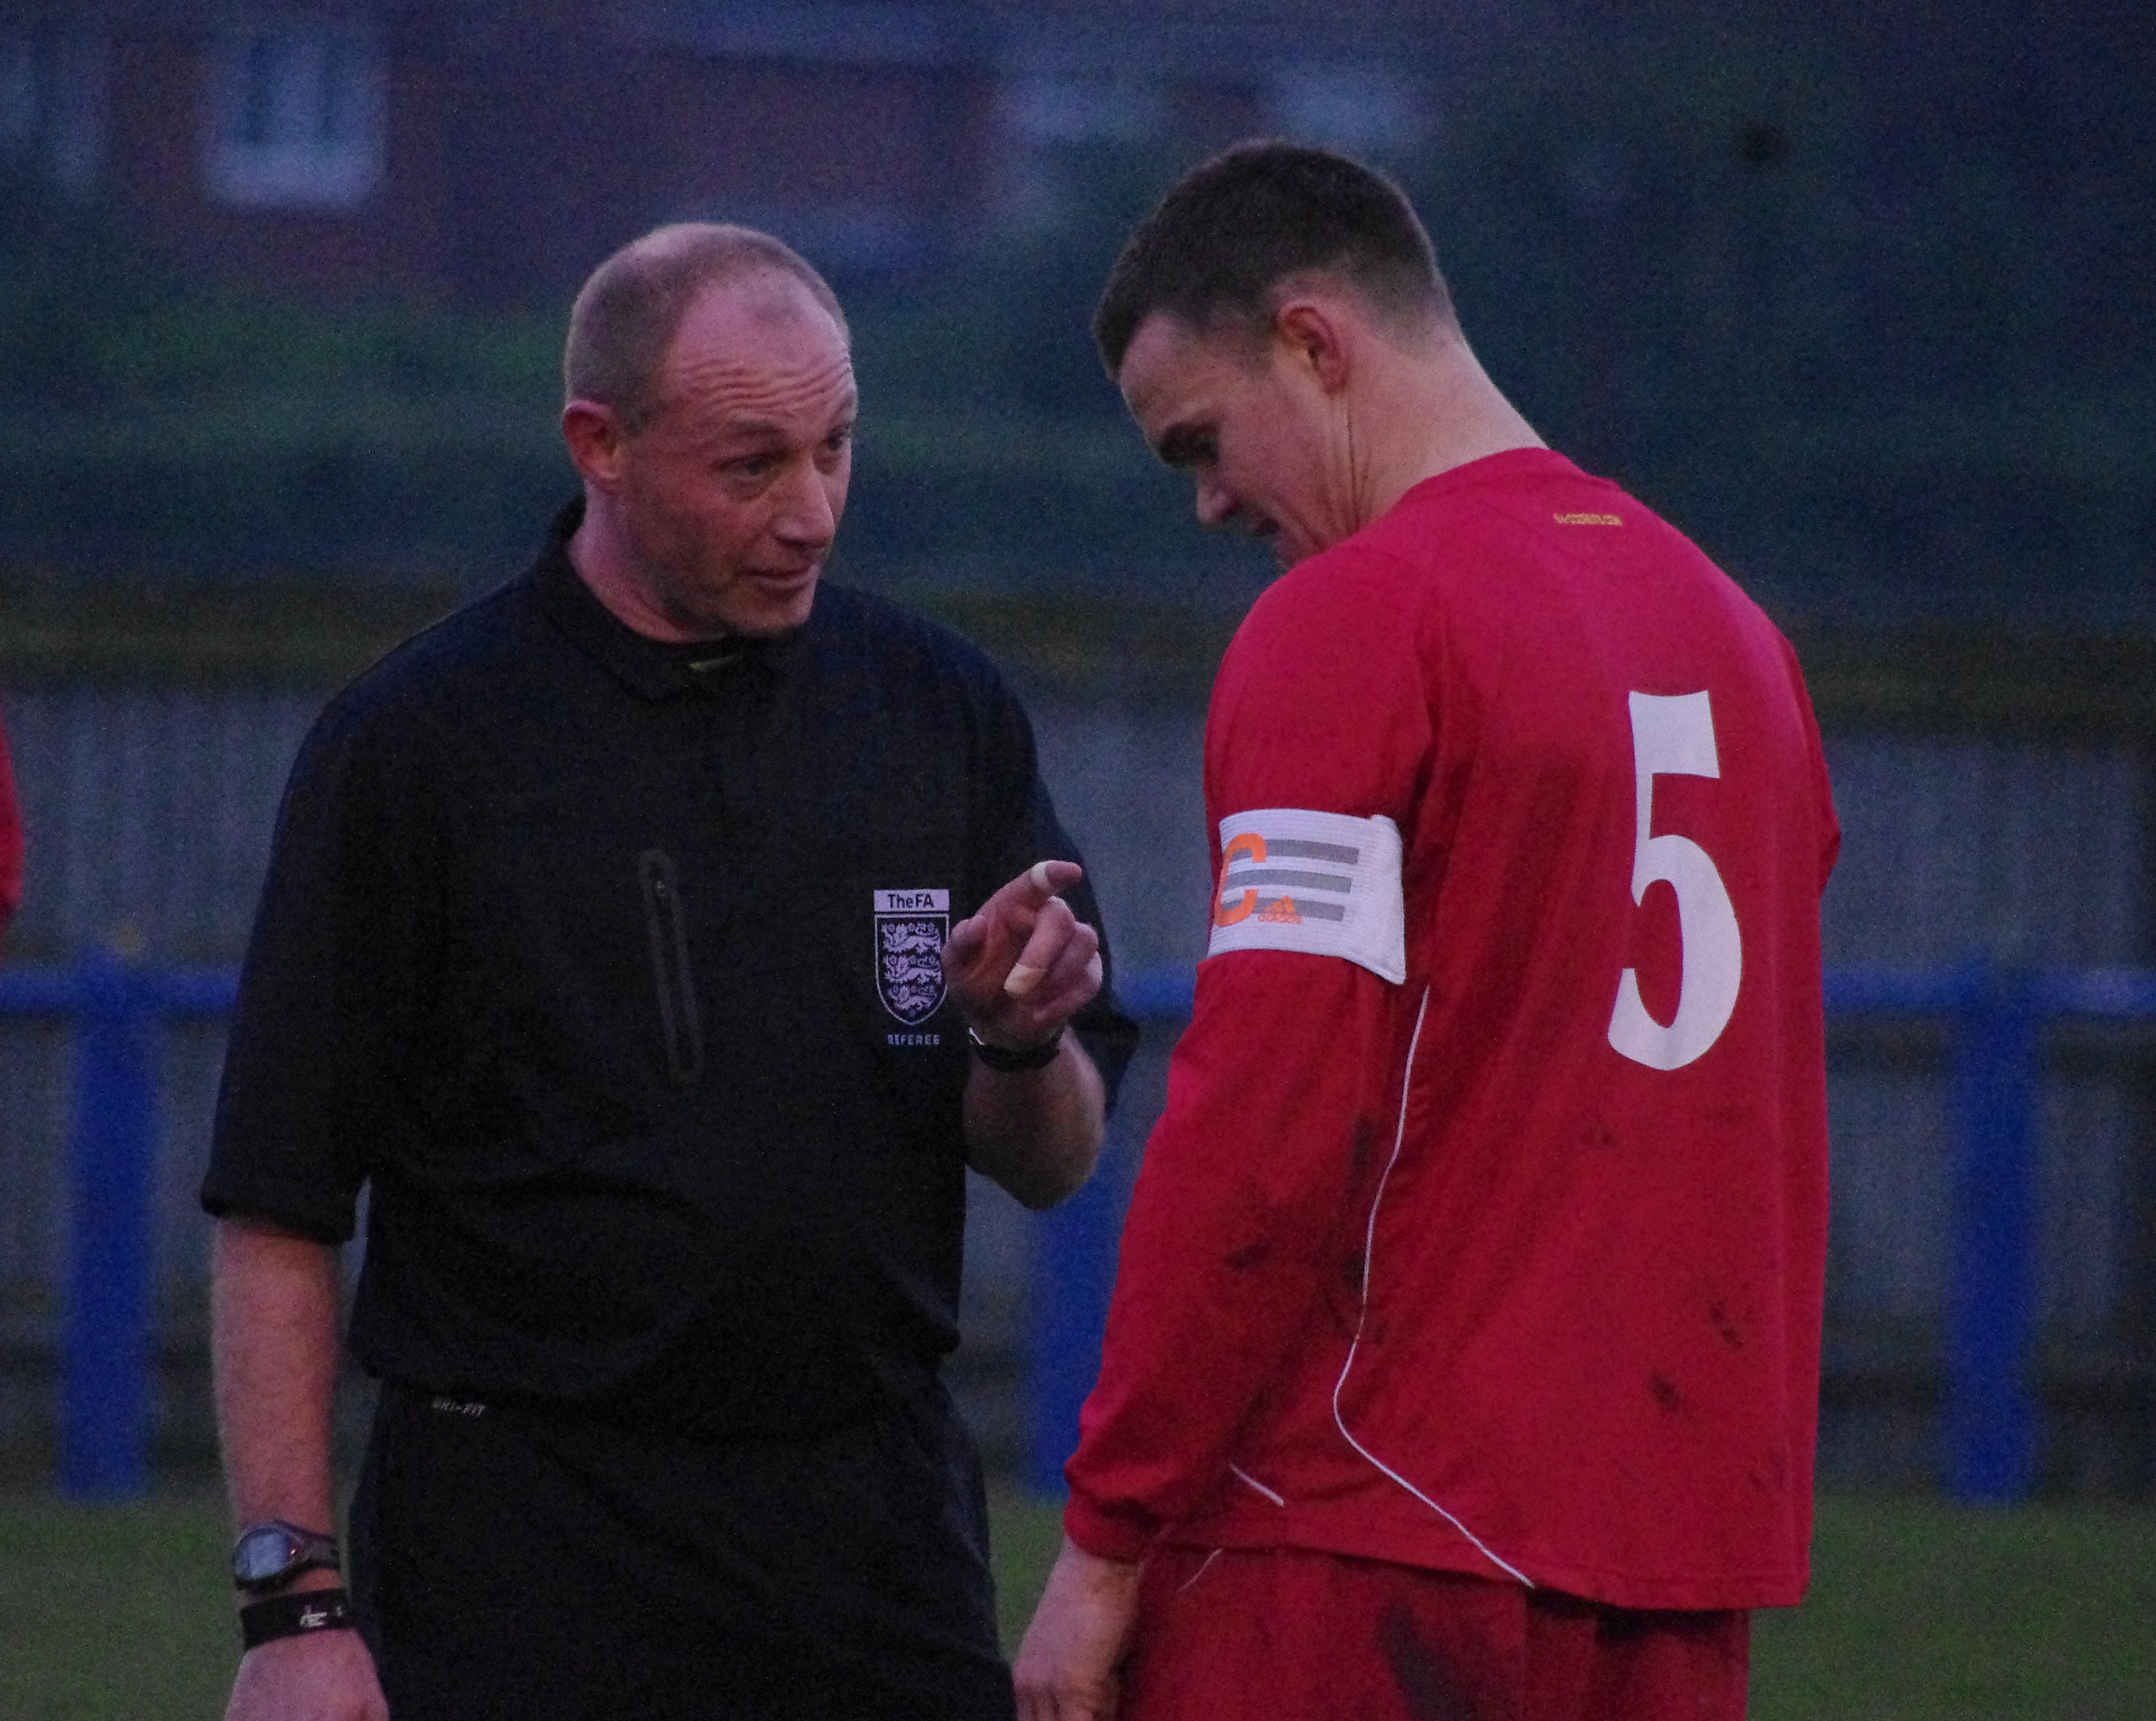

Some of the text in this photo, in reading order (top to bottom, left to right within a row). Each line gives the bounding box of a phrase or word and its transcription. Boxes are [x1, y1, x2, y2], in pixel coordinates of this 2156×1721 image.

[1213, 833, 1267, 927] C
[1607, 690, 1743, 1071] 5
[887, 1033, 940, 1045] REFEREE
